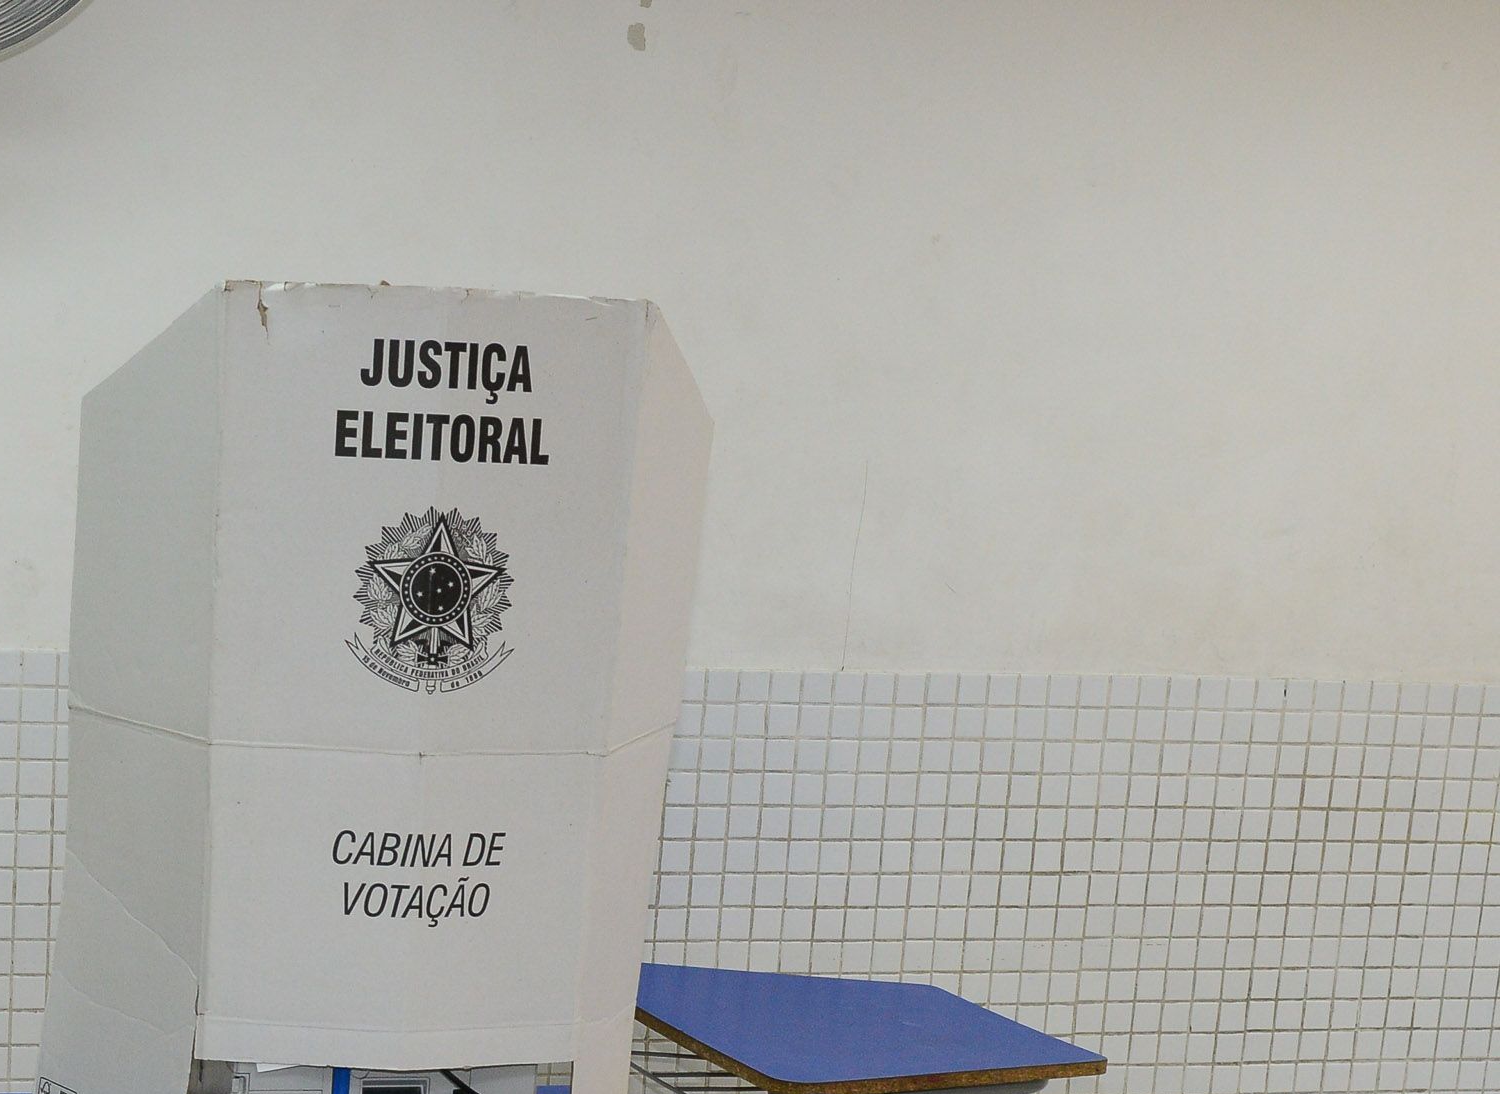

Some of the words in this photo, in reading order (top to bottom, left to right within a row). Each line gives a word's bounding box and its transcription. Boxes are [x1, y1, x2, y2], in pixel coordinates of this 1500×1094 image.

[360, 338, 533, 405] JUSTIÇA
[334, 409, 551, 466] ELEITORAL
[462, 654, 484, 671] BRASIL
[332, 830, 452, 867] CABINA
[463, 831, 507, 867] DE
[341, 876, 490, 928] VOTAÇÃO
